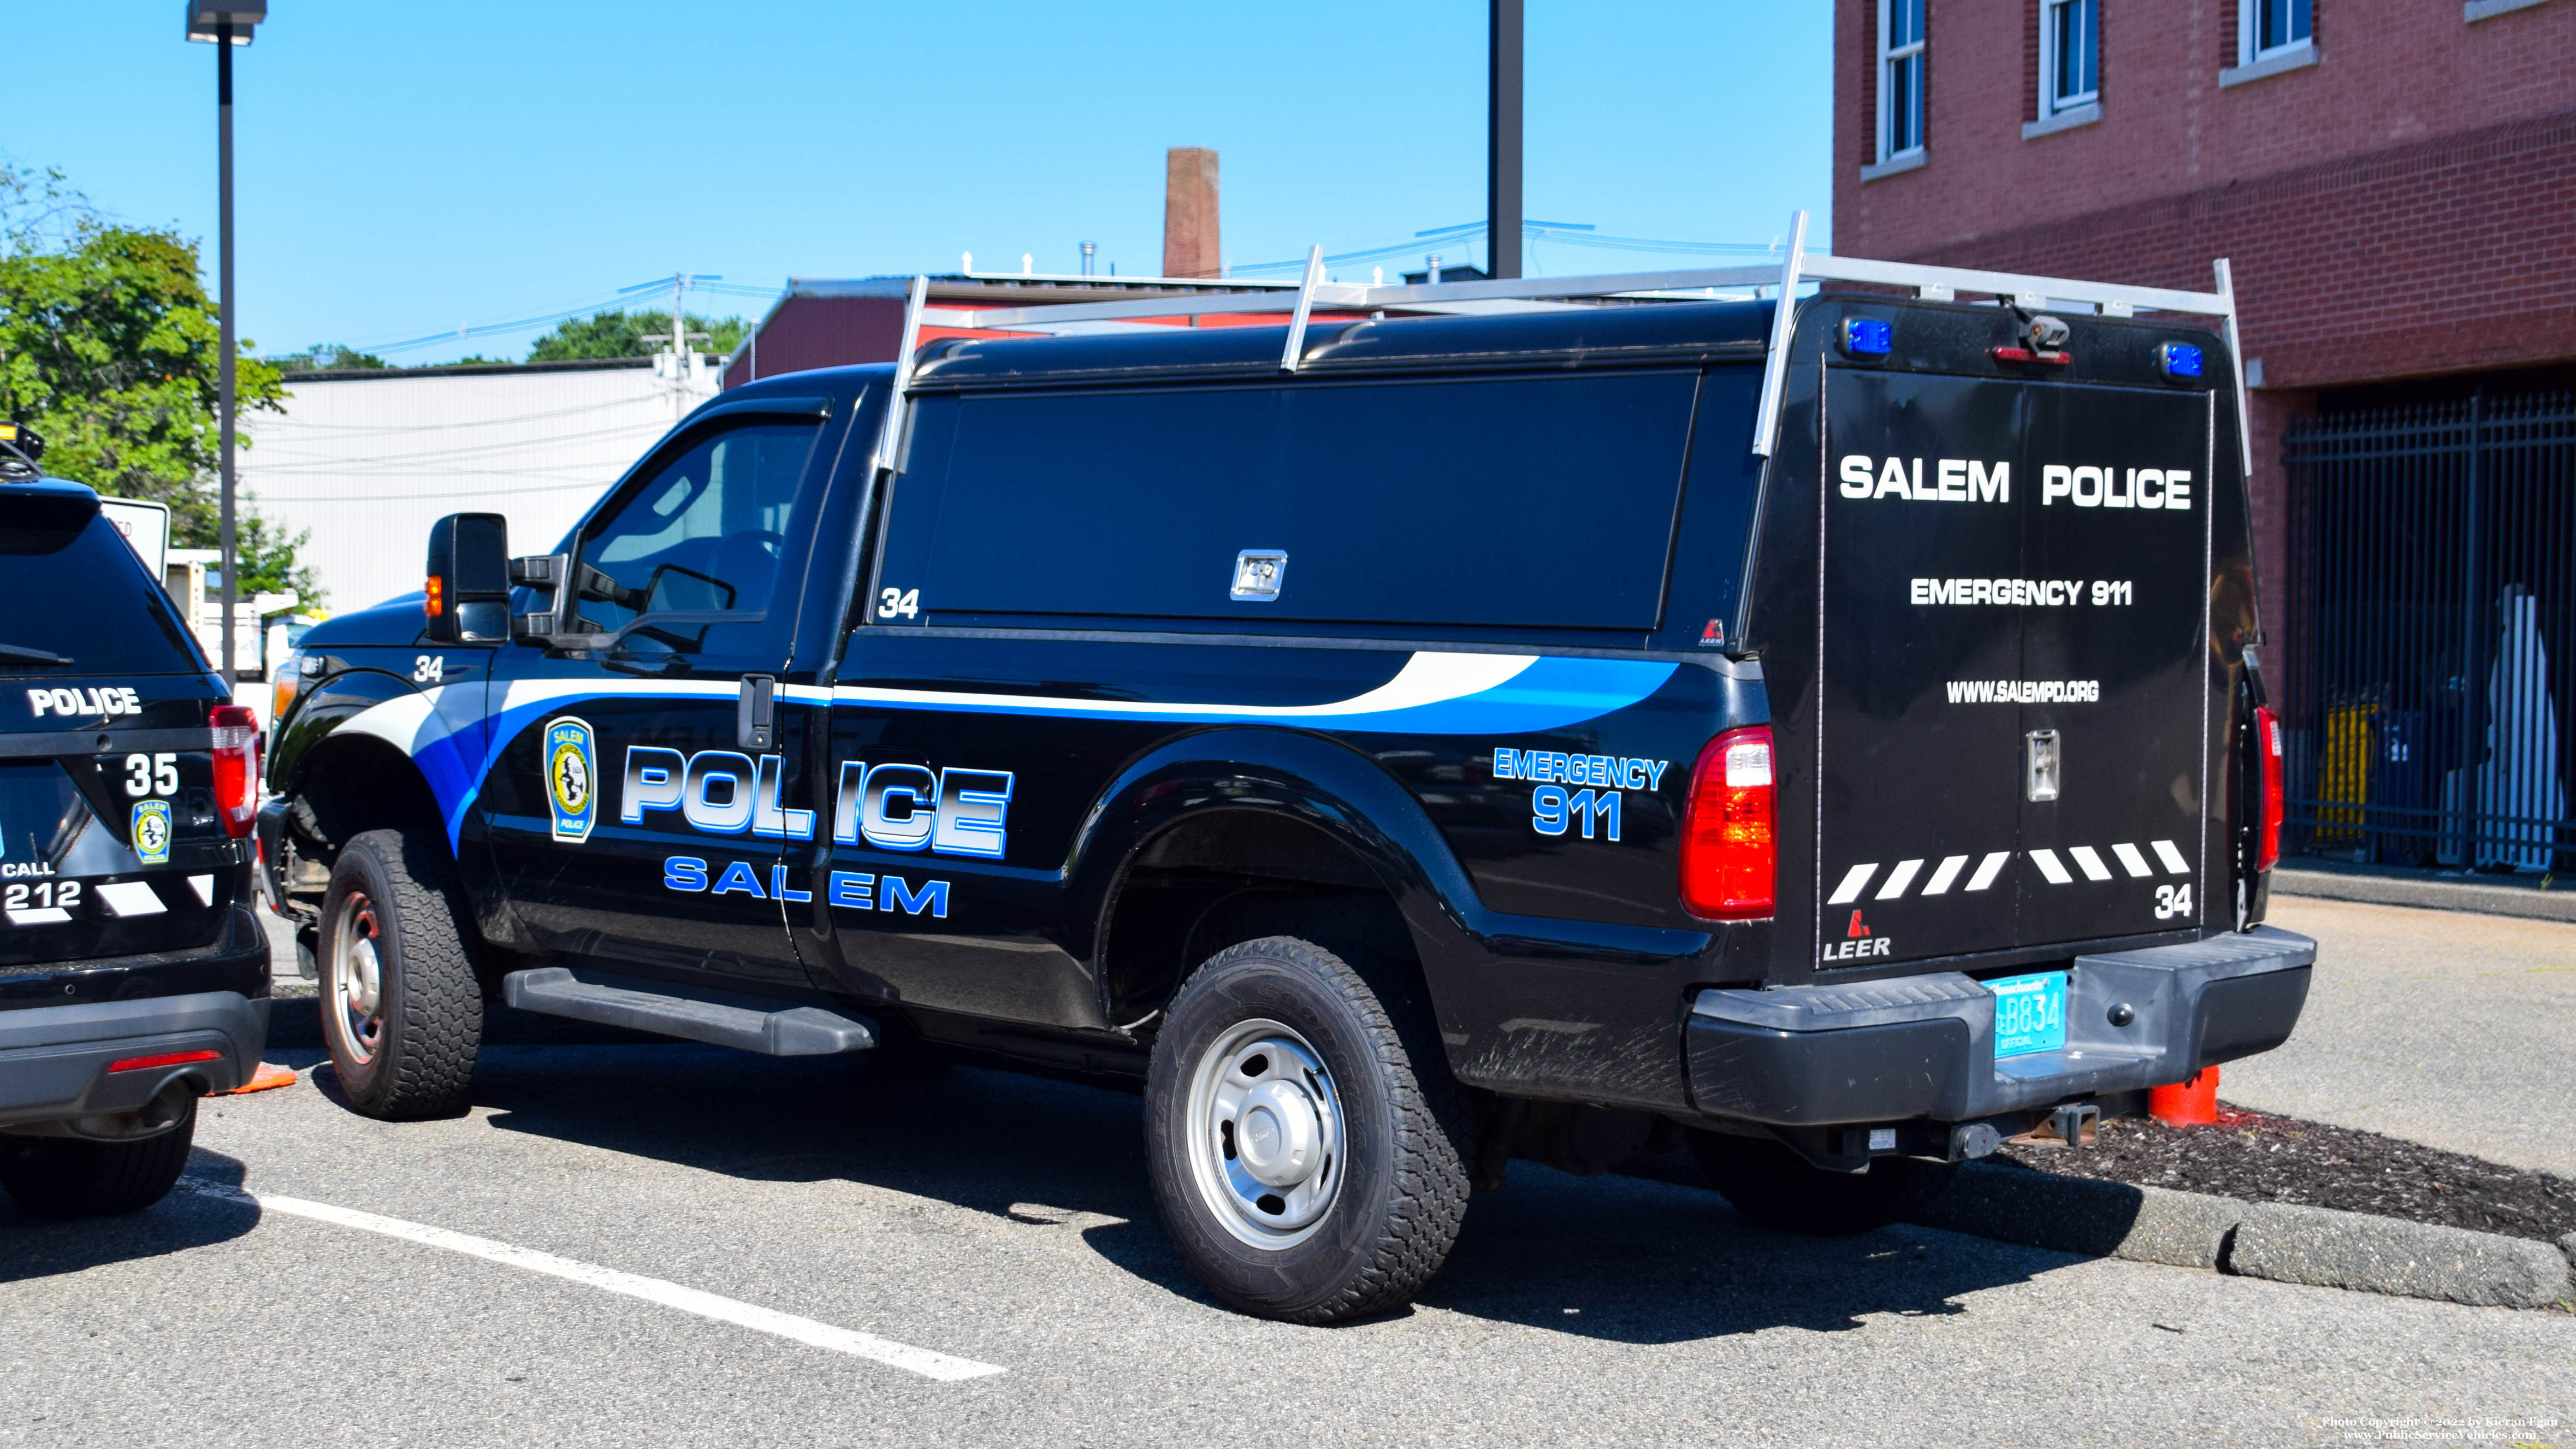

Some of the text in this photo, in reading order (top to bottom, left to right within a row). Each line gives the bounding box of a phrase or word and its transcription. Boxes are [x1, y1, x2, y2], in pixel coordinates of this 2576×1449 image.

[1840, 455, 2192, 510] SALEM POLICE
[878, 587, 920, 619] 34
[1911, 578, 2132, 606] EMERGENCY 911
[413, 655, 443, 682] 34
[28, 687, 142, 717] POLICE
[1946, 681, 2099, 703] WWW.SALEMPD.ORG
[553, 730, 584, 744] SALEM
[126, 753, 178, 796] 35
[1493, 747, 1669, 791] EMERGENCY
[621, 746, 1016, 859] POLICE
[1532, 785, 1621, 842] 911
[560, 819, 585, 830] POLICE
[2, 861, 56, 877] CALL
[4, 880, 81, 909] 212
[664, 855, 950, 919] SALEM
[2154, 883, 2192, 920] 34
[1823, 937, 1891, 961] LEER
